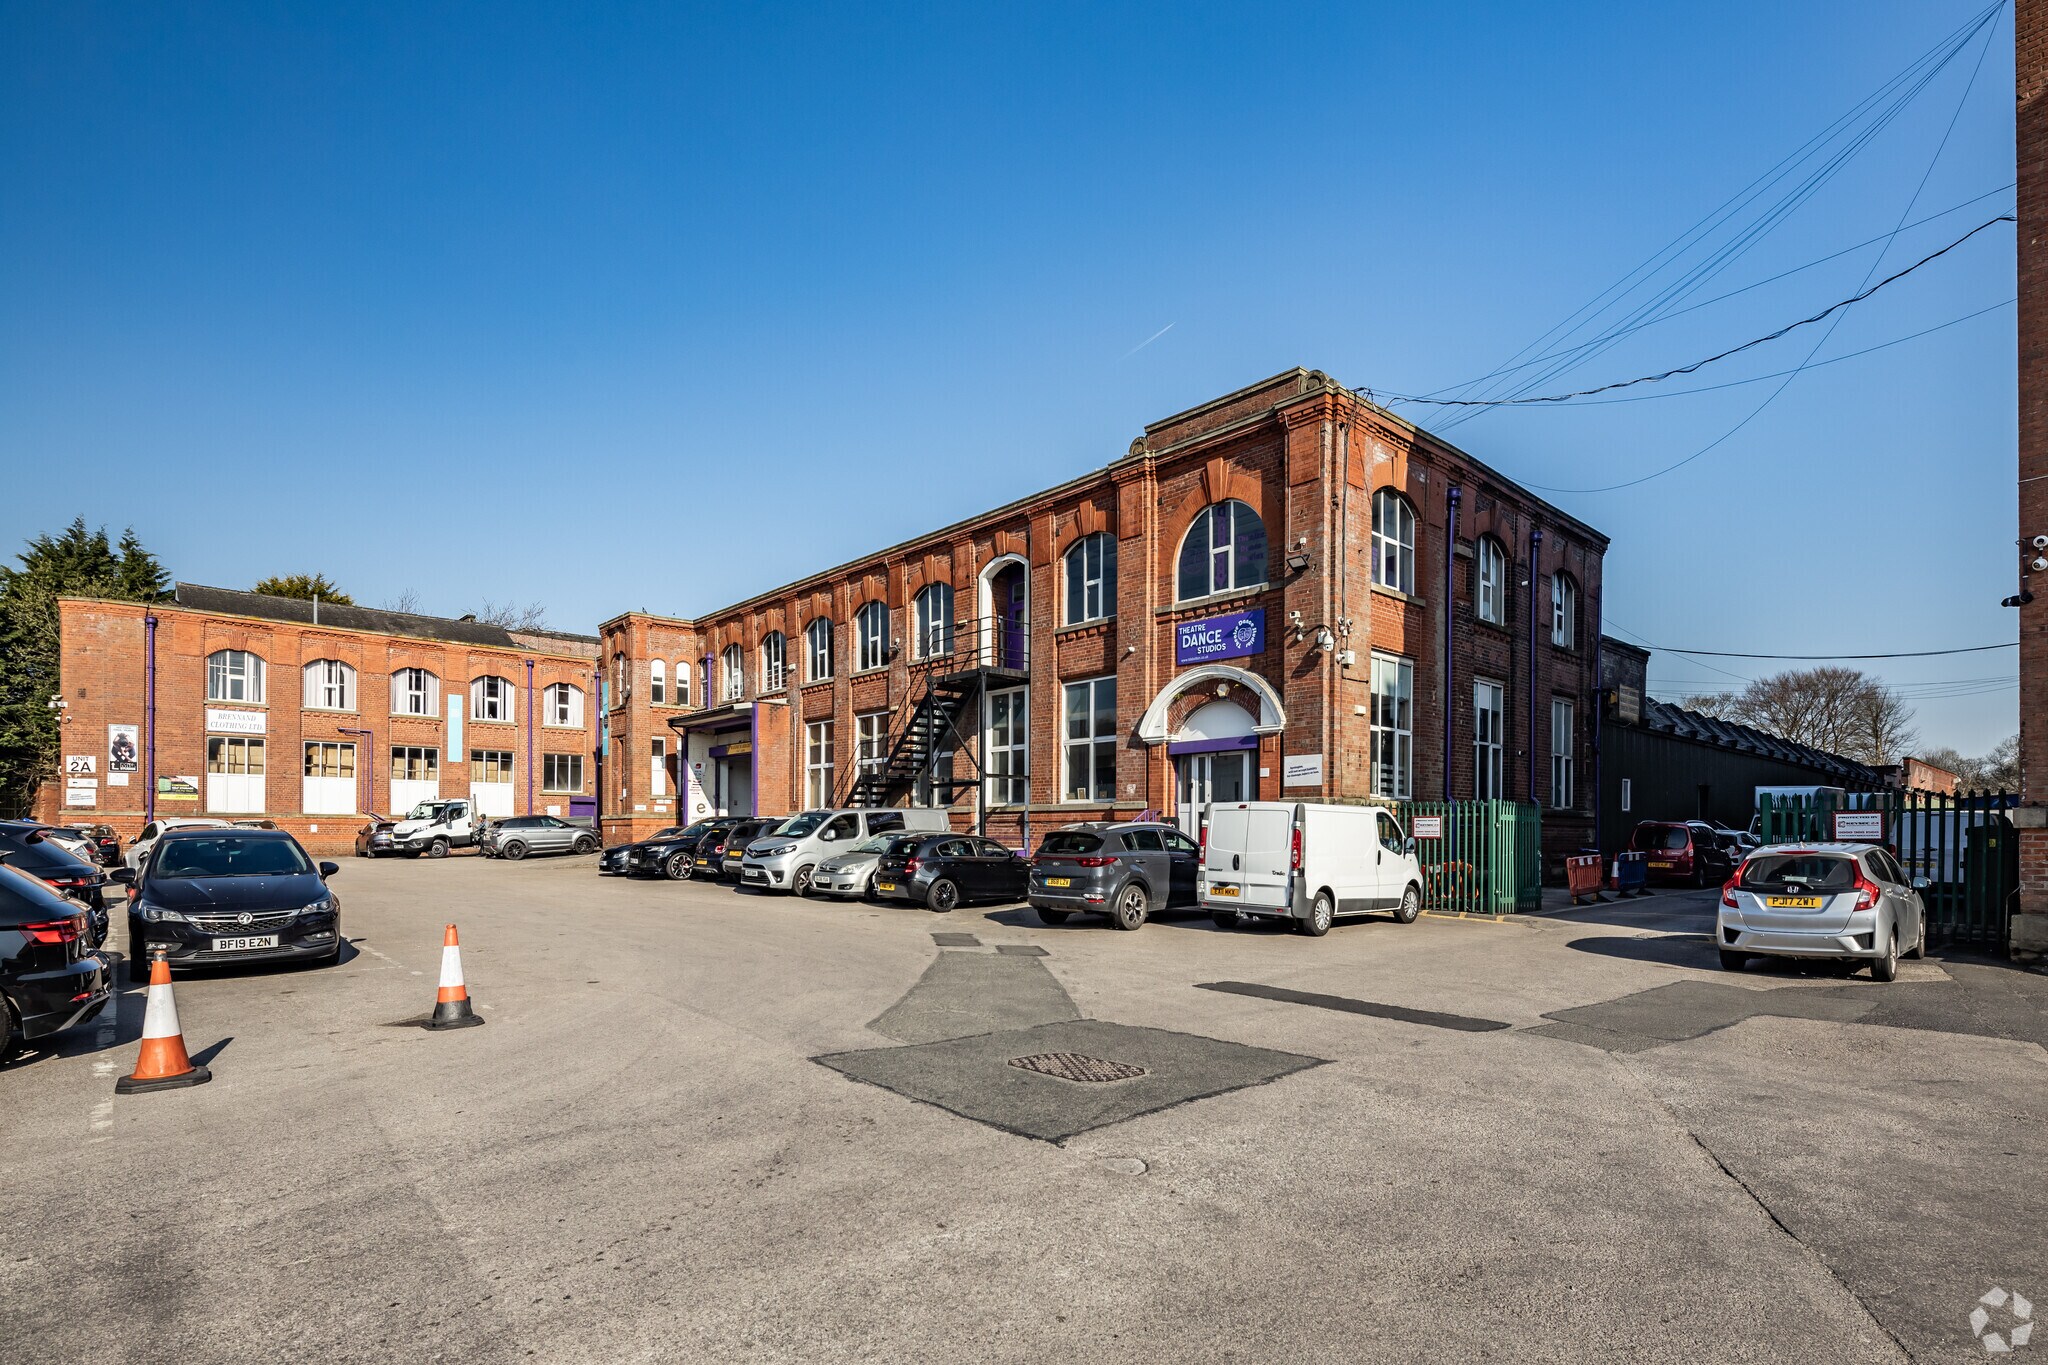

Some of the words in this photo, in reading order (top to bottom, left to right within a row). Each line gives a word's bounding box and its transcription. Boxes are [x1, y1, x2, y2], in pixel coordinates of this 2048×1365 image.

[1238, 619, 1254, 627] Dance
[1179, 623, 1206, 635] THEATRE
[1182, 629, 1222, 649] DANCE
[1197, 643, 1227, 654] STUDIOS
[218, 713, 256, 721] BRENNAND
[210, 721, 248, 729] CLOTHING
[70, 761, 91, 772] 2A
[1772, 897, 1794, 905] PJ17
[1796, 897, 1816, 905] ZWT
[220, 939, 246, 949] BF19
[249, 937, 271, 947] EZN
